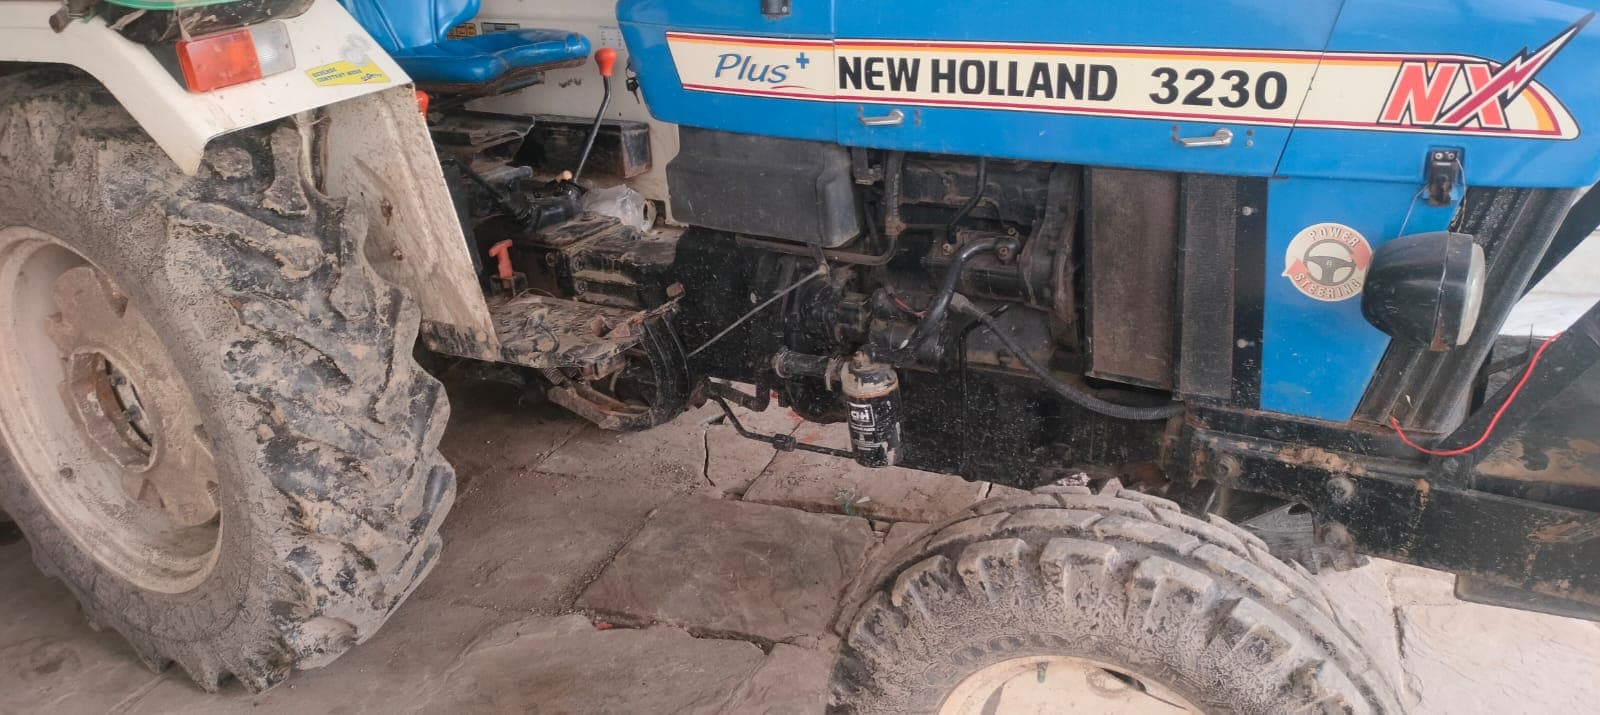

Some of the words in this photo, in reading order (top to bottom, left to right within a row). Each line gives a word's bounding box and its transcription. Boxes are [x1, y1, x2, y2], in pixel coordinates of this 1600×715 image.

[838, 56, 920, 92] NEW
[930, 59, 1118, 101] HOLLAND
[1149, 67, 1288, 110] 3230
[1377, 60, 1528, 130] NX
[1308, 227, 1360, 247] POWER
[1295, 273, 1361, 299] STEERING
